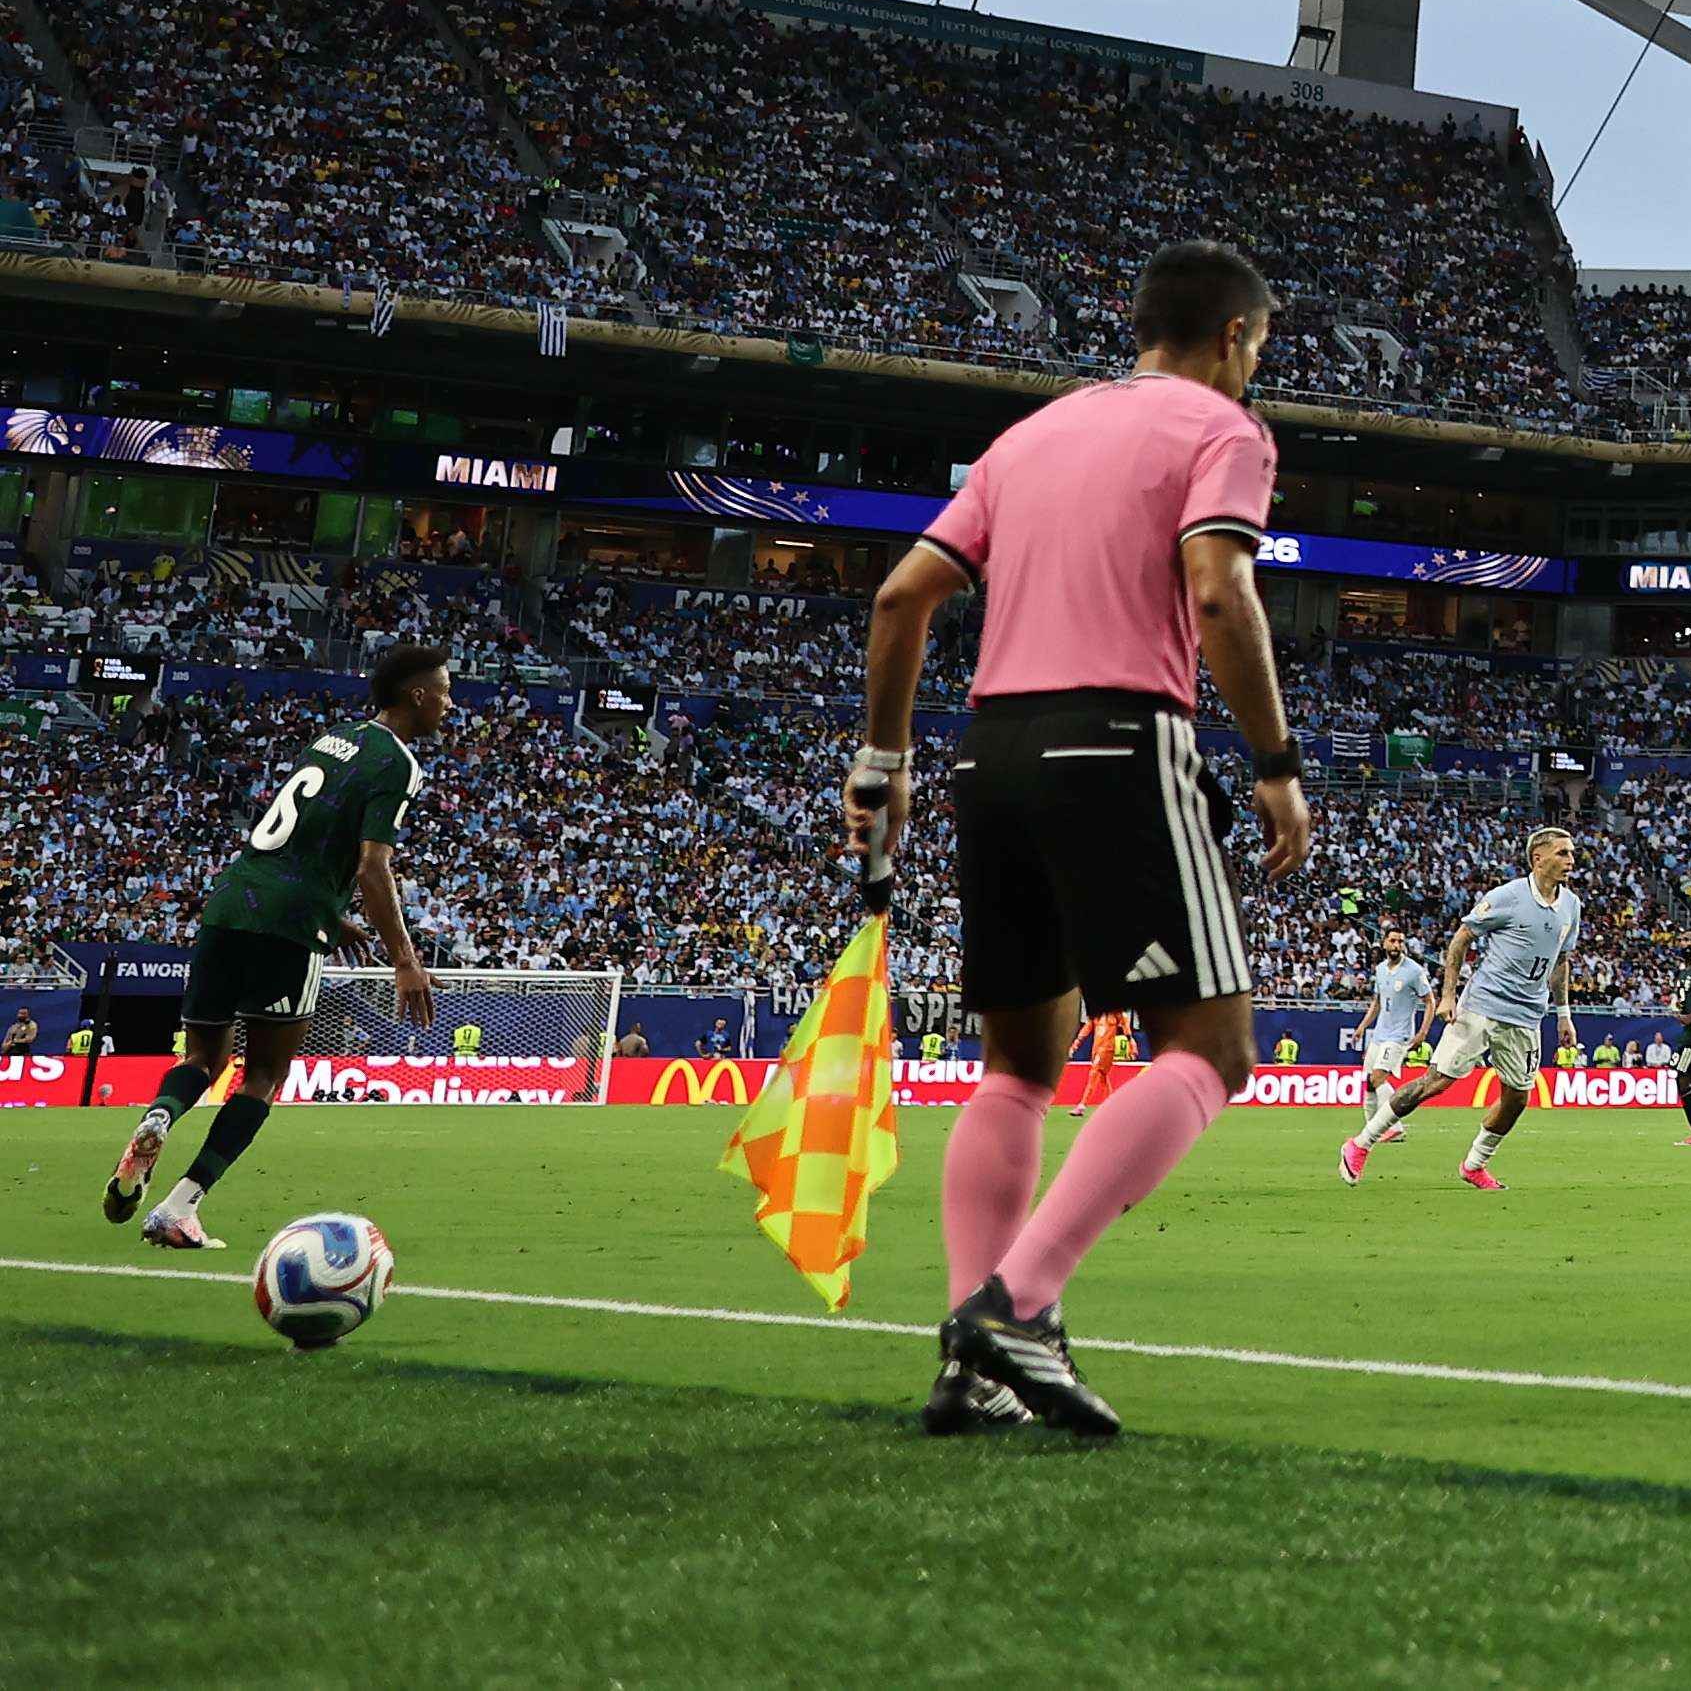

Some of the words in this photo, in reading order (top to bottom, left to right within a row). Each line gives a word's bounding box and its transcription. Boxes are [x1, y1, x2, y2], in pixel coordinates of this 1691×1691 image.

[1290, 80, 1324, 102] 308
[435, 454, 558, 492] MIAMI
[250, 765, 325, 851] 6
[1528, 955, 1551, 982] 13
